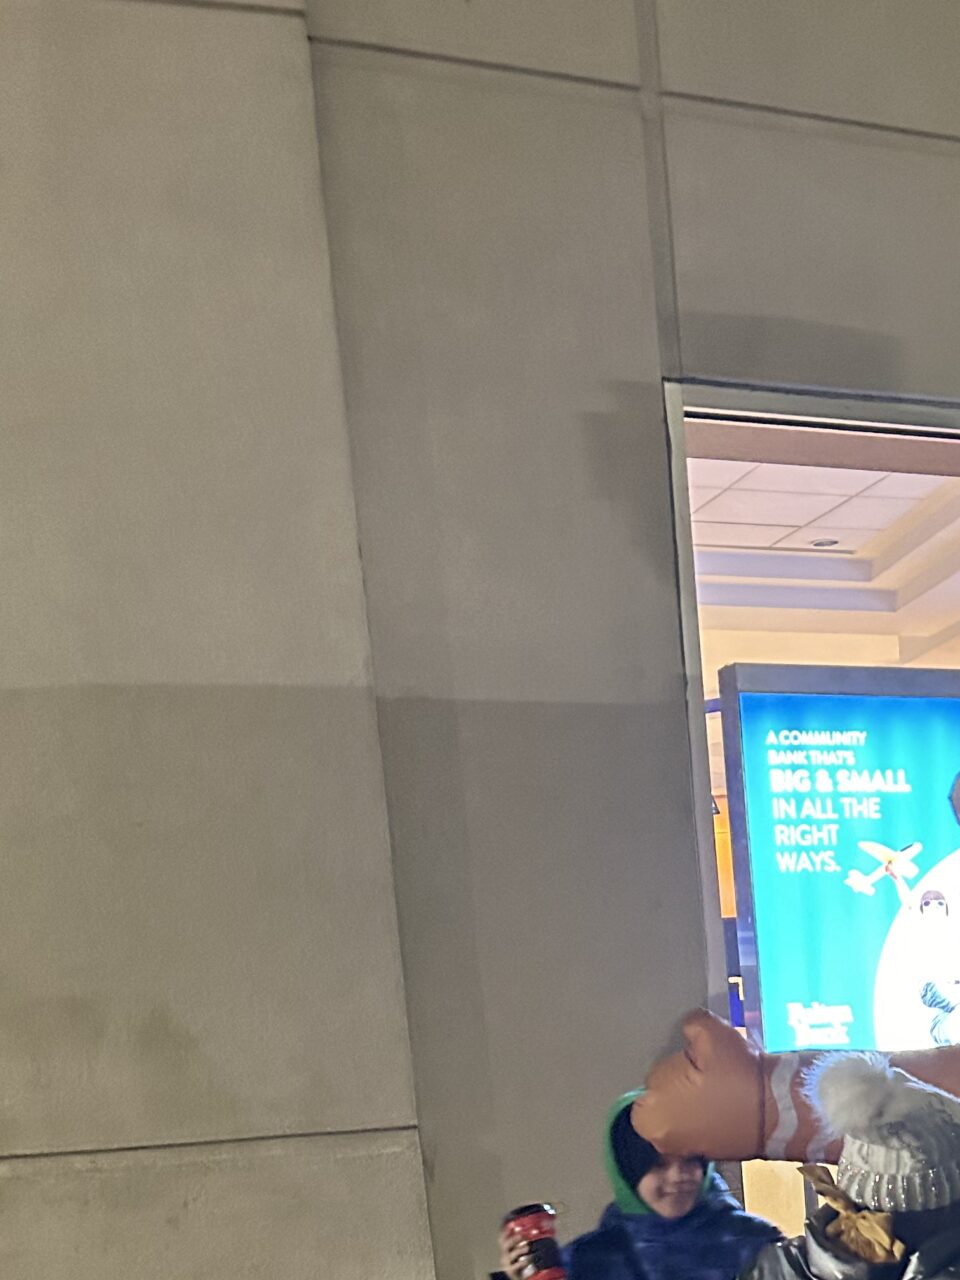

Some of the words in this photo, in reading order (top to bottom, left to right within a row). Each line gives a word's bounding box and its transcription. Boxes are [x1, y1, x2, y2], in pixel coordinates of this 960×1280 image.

[766, 730, 778, 745] A
[778, 730, 867, 746] COMMUNITY
[768, 750, 808, 765] BANK
[809, 750, 856, 766] THAT'S
[769, 769, 812, 793] BIG
[815, 769, 834, 792] &
[836, 769, 912, 793] SMALL
[772, 798, 797, 819] IN
[800, 797, 839, 819] ALL
[840, 797, 882, 819] THE
[774, 824, 840, 846] RIGHT
[776, 851, 841, 873] WAYS.
